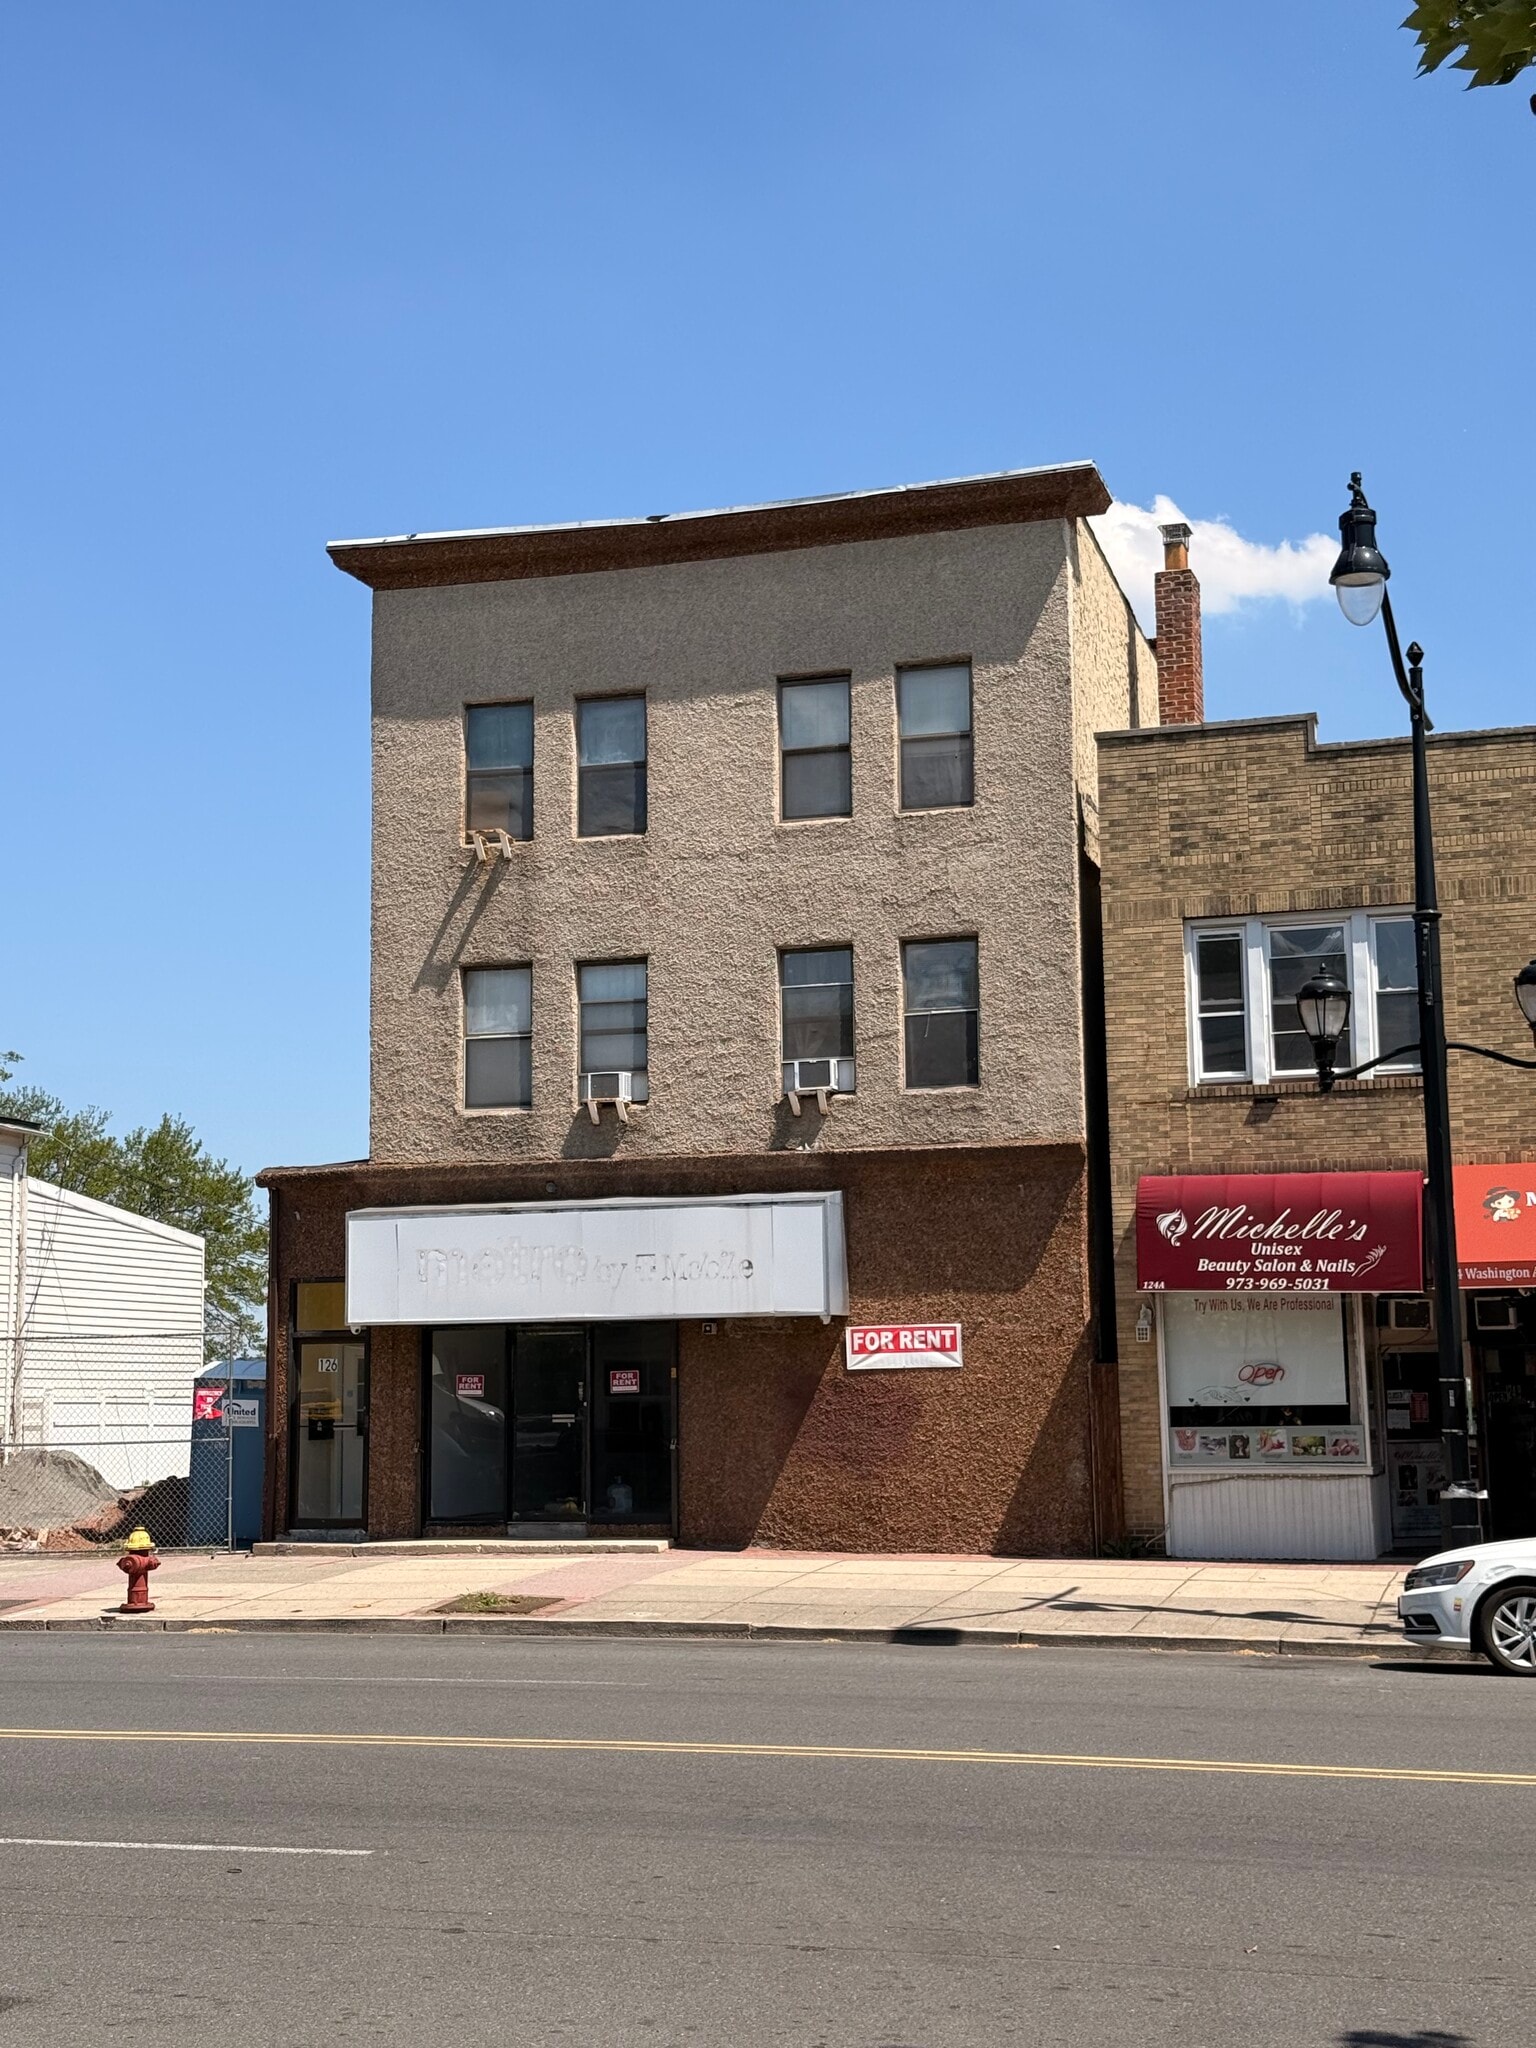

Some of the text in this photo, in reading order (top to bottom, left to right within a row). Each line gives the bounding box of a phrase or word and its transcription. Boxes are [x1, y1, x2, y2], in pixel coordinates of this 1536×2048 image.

[1191, 1204, 1368, 1241] Michelle's
[1250, 1242, 1303, 1256] Unisex
[1197, 1258, 1355, 1275] Beauty Salon & Nails
[1465, 1266, 1531, 1282] Washington
[1142, 1280, 1165, 1290] 124A
[1226, 1277, 1330, 1290] 973-969-5031
[1194, 1299, 1207, 1314] Try
[1208, 1298, 1228, 1311] With
[1247, 1298, 1260, 1311] We
[1263, 1299, 1278, 1311] Are
[1280, 1297, 1334, 1311] Professional
[853, 1329, 955, 1352] FOR RENT
[320, 1359, 338, 1372] 126
[461, 1376, 479, 1384] FOR
[616, 1372, 634, 1380] FOR
[1238, 1364, 1285, 1382] Open
[227, 1407, 256, 1416] United
